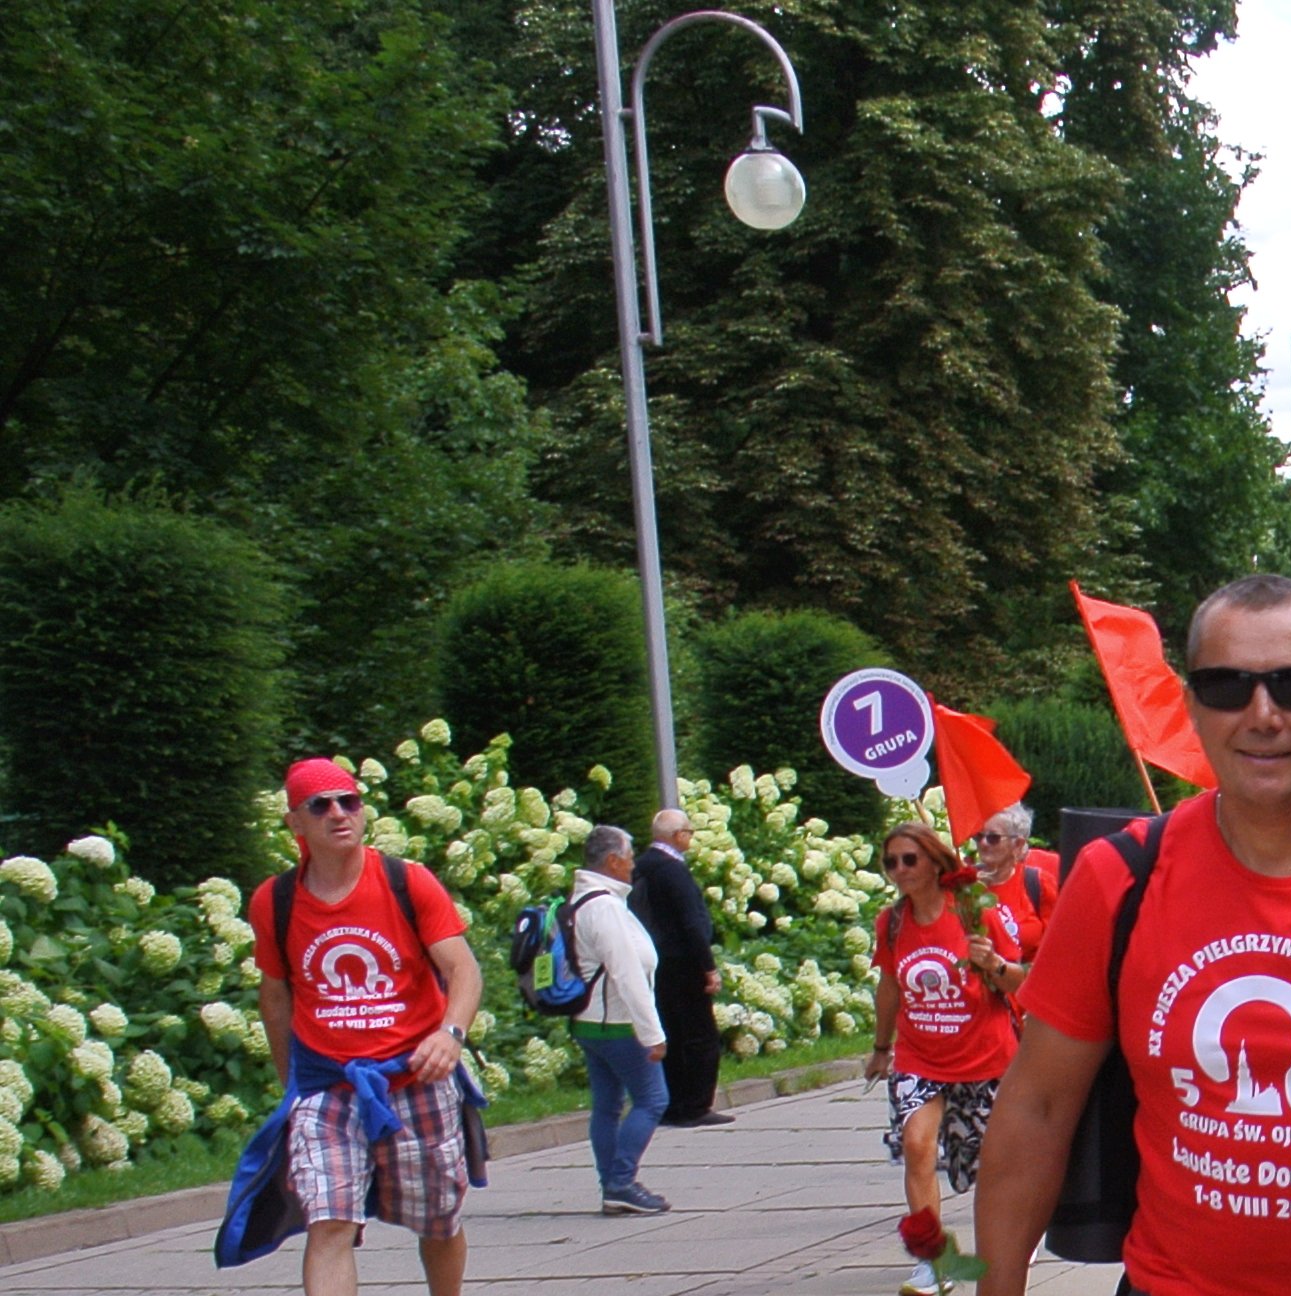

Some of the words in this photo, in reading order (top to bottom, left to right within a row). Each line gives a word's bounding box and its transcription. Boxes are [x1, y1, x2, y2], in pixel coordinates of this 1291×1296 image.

[852, 690, 883, 736] 7
[864, 730, 918, 760] GRUPA
[1152, 963, 1197, 1026] PIESZA
[1148, 1029, 1163, 1057] XX
[1170, 1067, 1200, 1107] 5
[1179, 1111, 1230, 1138] GRUPA
[1233, 1119, 1266, 1142] ŚW.
[1172, 1136, 1251, 1184] Laudate
[1194, 1184, 1223, 1210] 1-8
[1228, 1194, 1269, 1217] VIII
